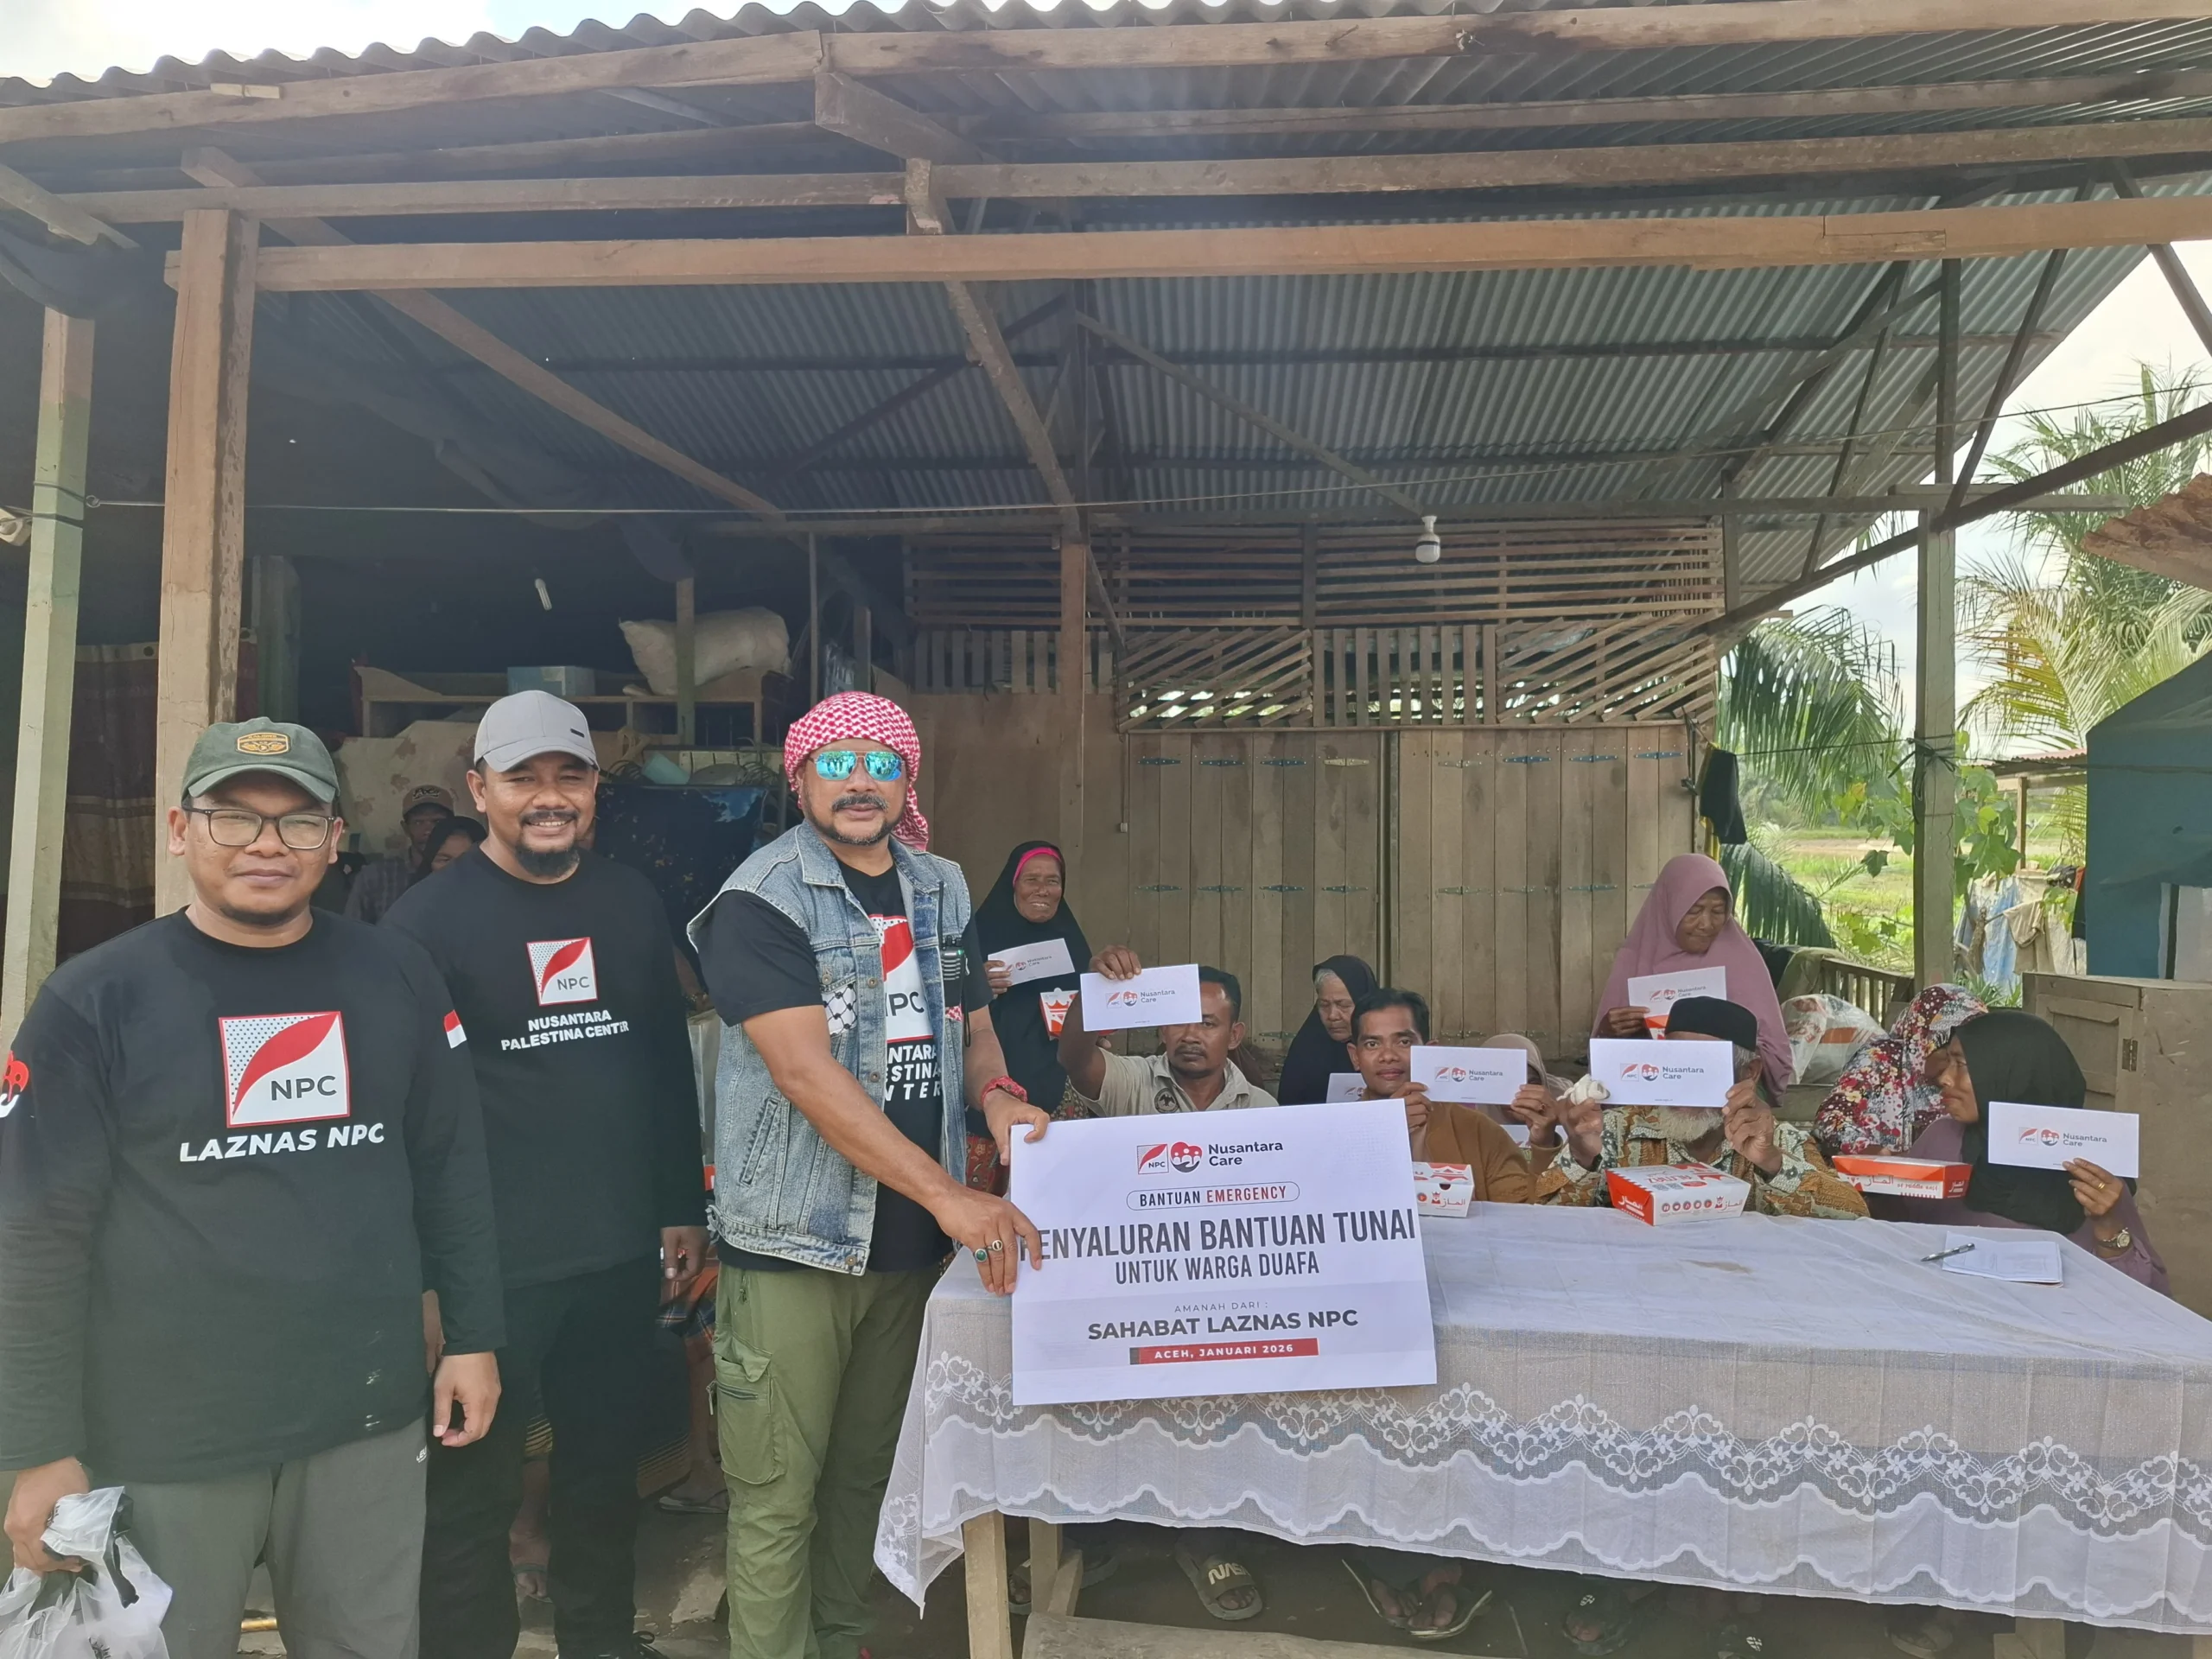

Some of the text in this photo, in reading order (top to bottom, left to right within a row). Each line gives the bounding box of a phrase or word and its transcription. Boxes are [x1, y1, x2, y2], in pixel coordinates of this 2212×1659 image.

[557, 976, 589, 990] NPC
[1140, 989, 1176, 998] Nusantara
[885, 991, 925, 1017] PC
[528, 1009, 612, 1032] NUSANTARA
[500, 1020, 630, 1051] PALESTINA CENTER
[1662, 1065, 1705, 1074] Nusantara
[270, 1075, 337, 1101] NPC
[180, 1122, 385, 1162] LAZNAS NPC
[1208, 1141, 1284, 1155] Nusantara
[2063, 1133, 2107, 1143] Nusantara
[1209, 1155, 1243, 1166] Care
[1140, 1185, 1287, 1207] BANTUAN EMERGENCY
[1200, 1213, 1325, 1250] BANTUAN
[1332, 1209, 1415, 1243] TUNAI
[1115, 1251, 1320, 1285] UNTUK WARGA DUAFA
[1174, 1302, 1226, 1313] AMANAH
[1231, 1300, 1261, 1310] DARI
[1088, 1309, 1359, 1340] SAHABAT LAZNAS NPC
[1154, 1344, 1294, 1360] ACEH, JANUARI 2026
